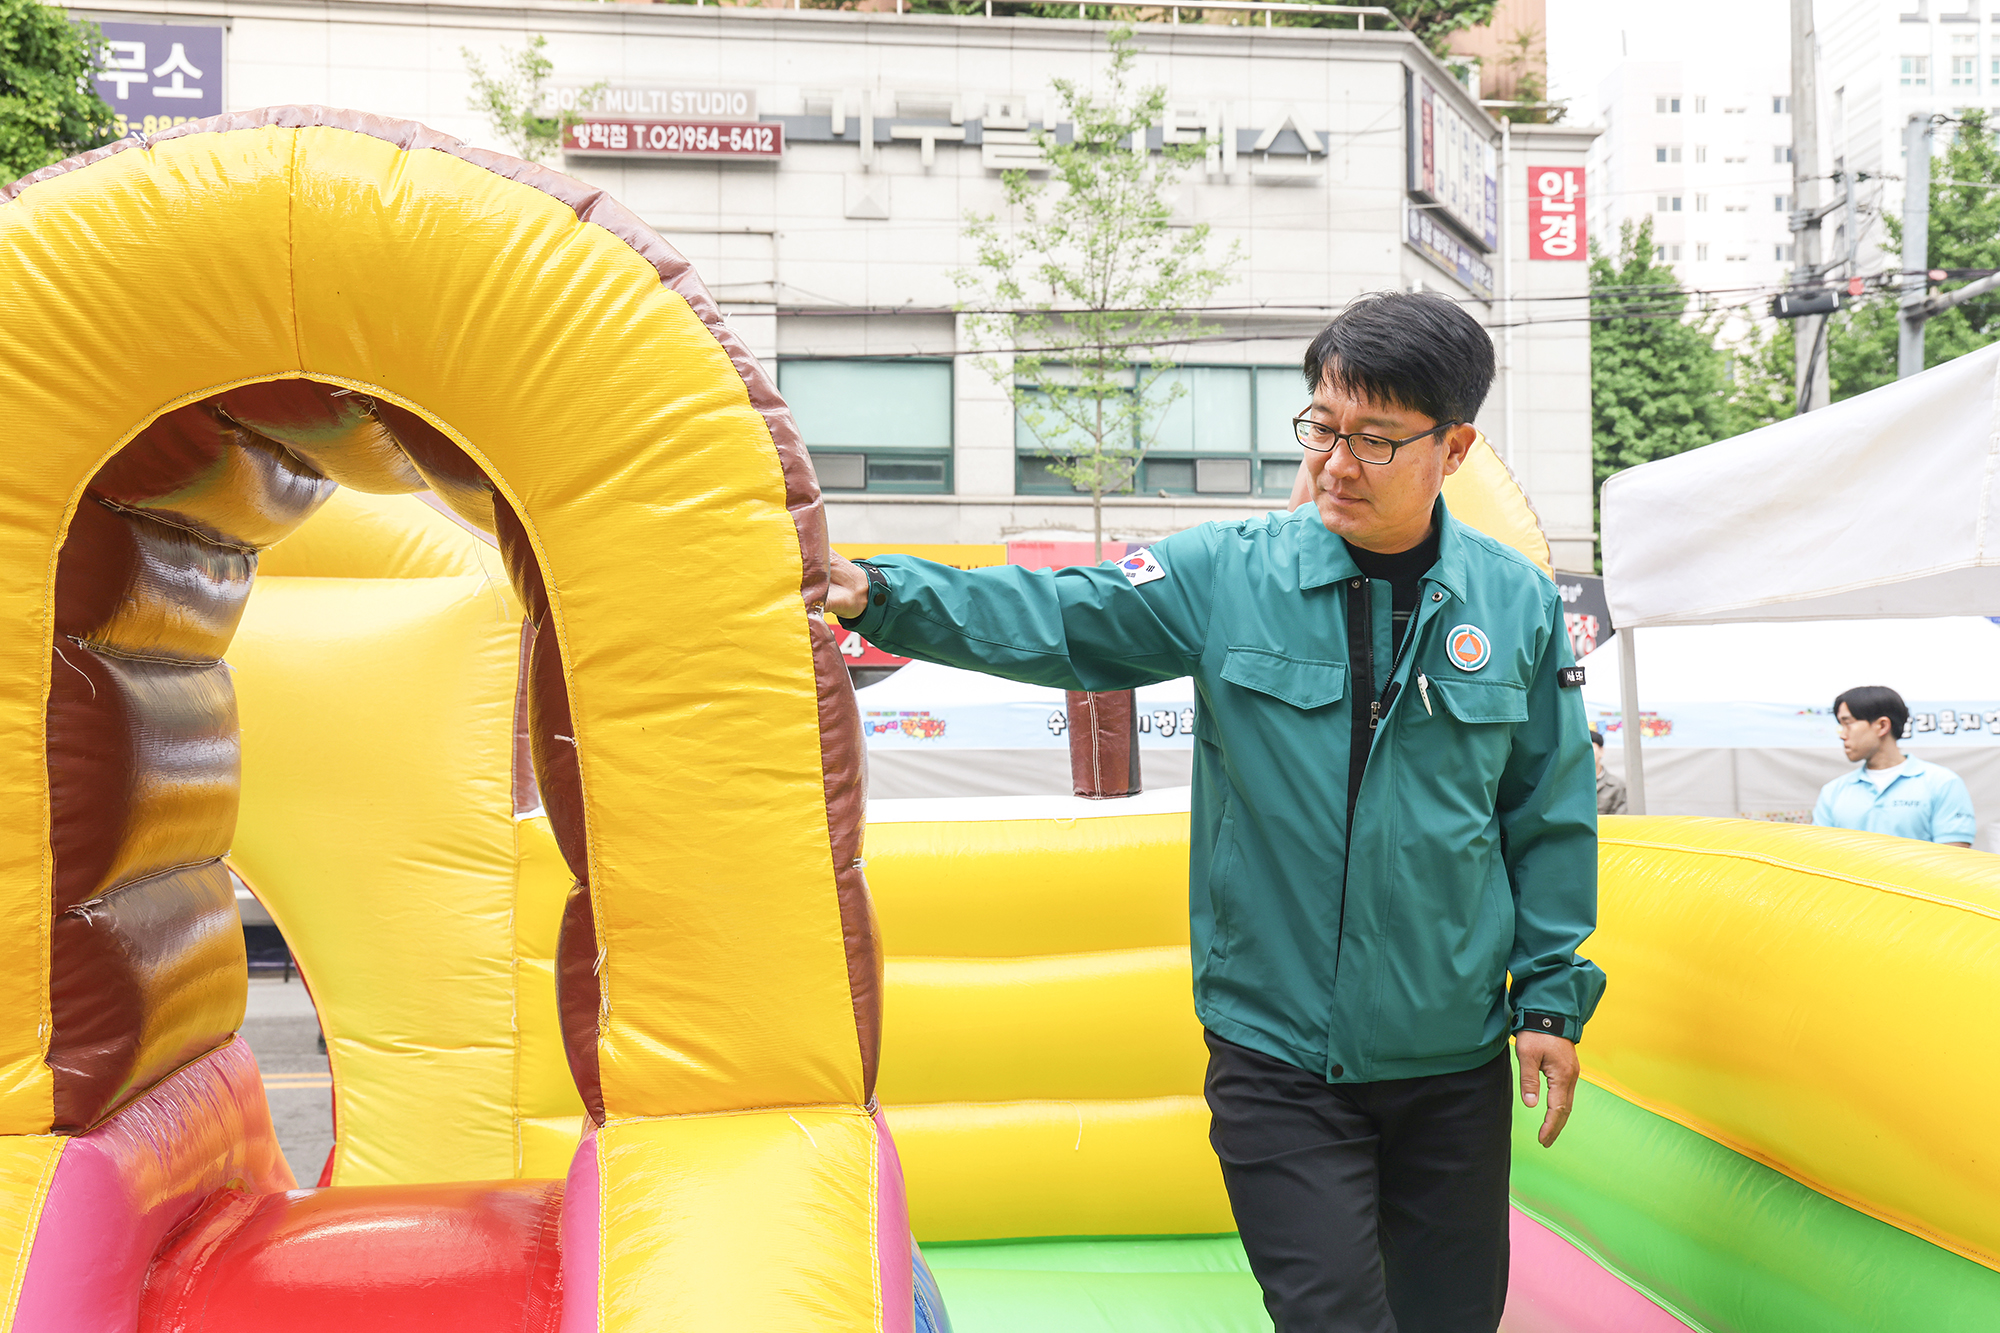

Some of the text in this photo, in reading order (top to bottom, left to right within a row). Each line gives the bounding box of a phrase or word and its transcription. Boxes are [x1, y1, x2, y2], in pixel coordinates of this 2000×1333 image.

[605, 89, 667, 113] MULTI
[671, 91, 748, 115] STUDIO
[573, 124, 628, 149] 방학점
[1537, 171, 1579, 256] 안경
